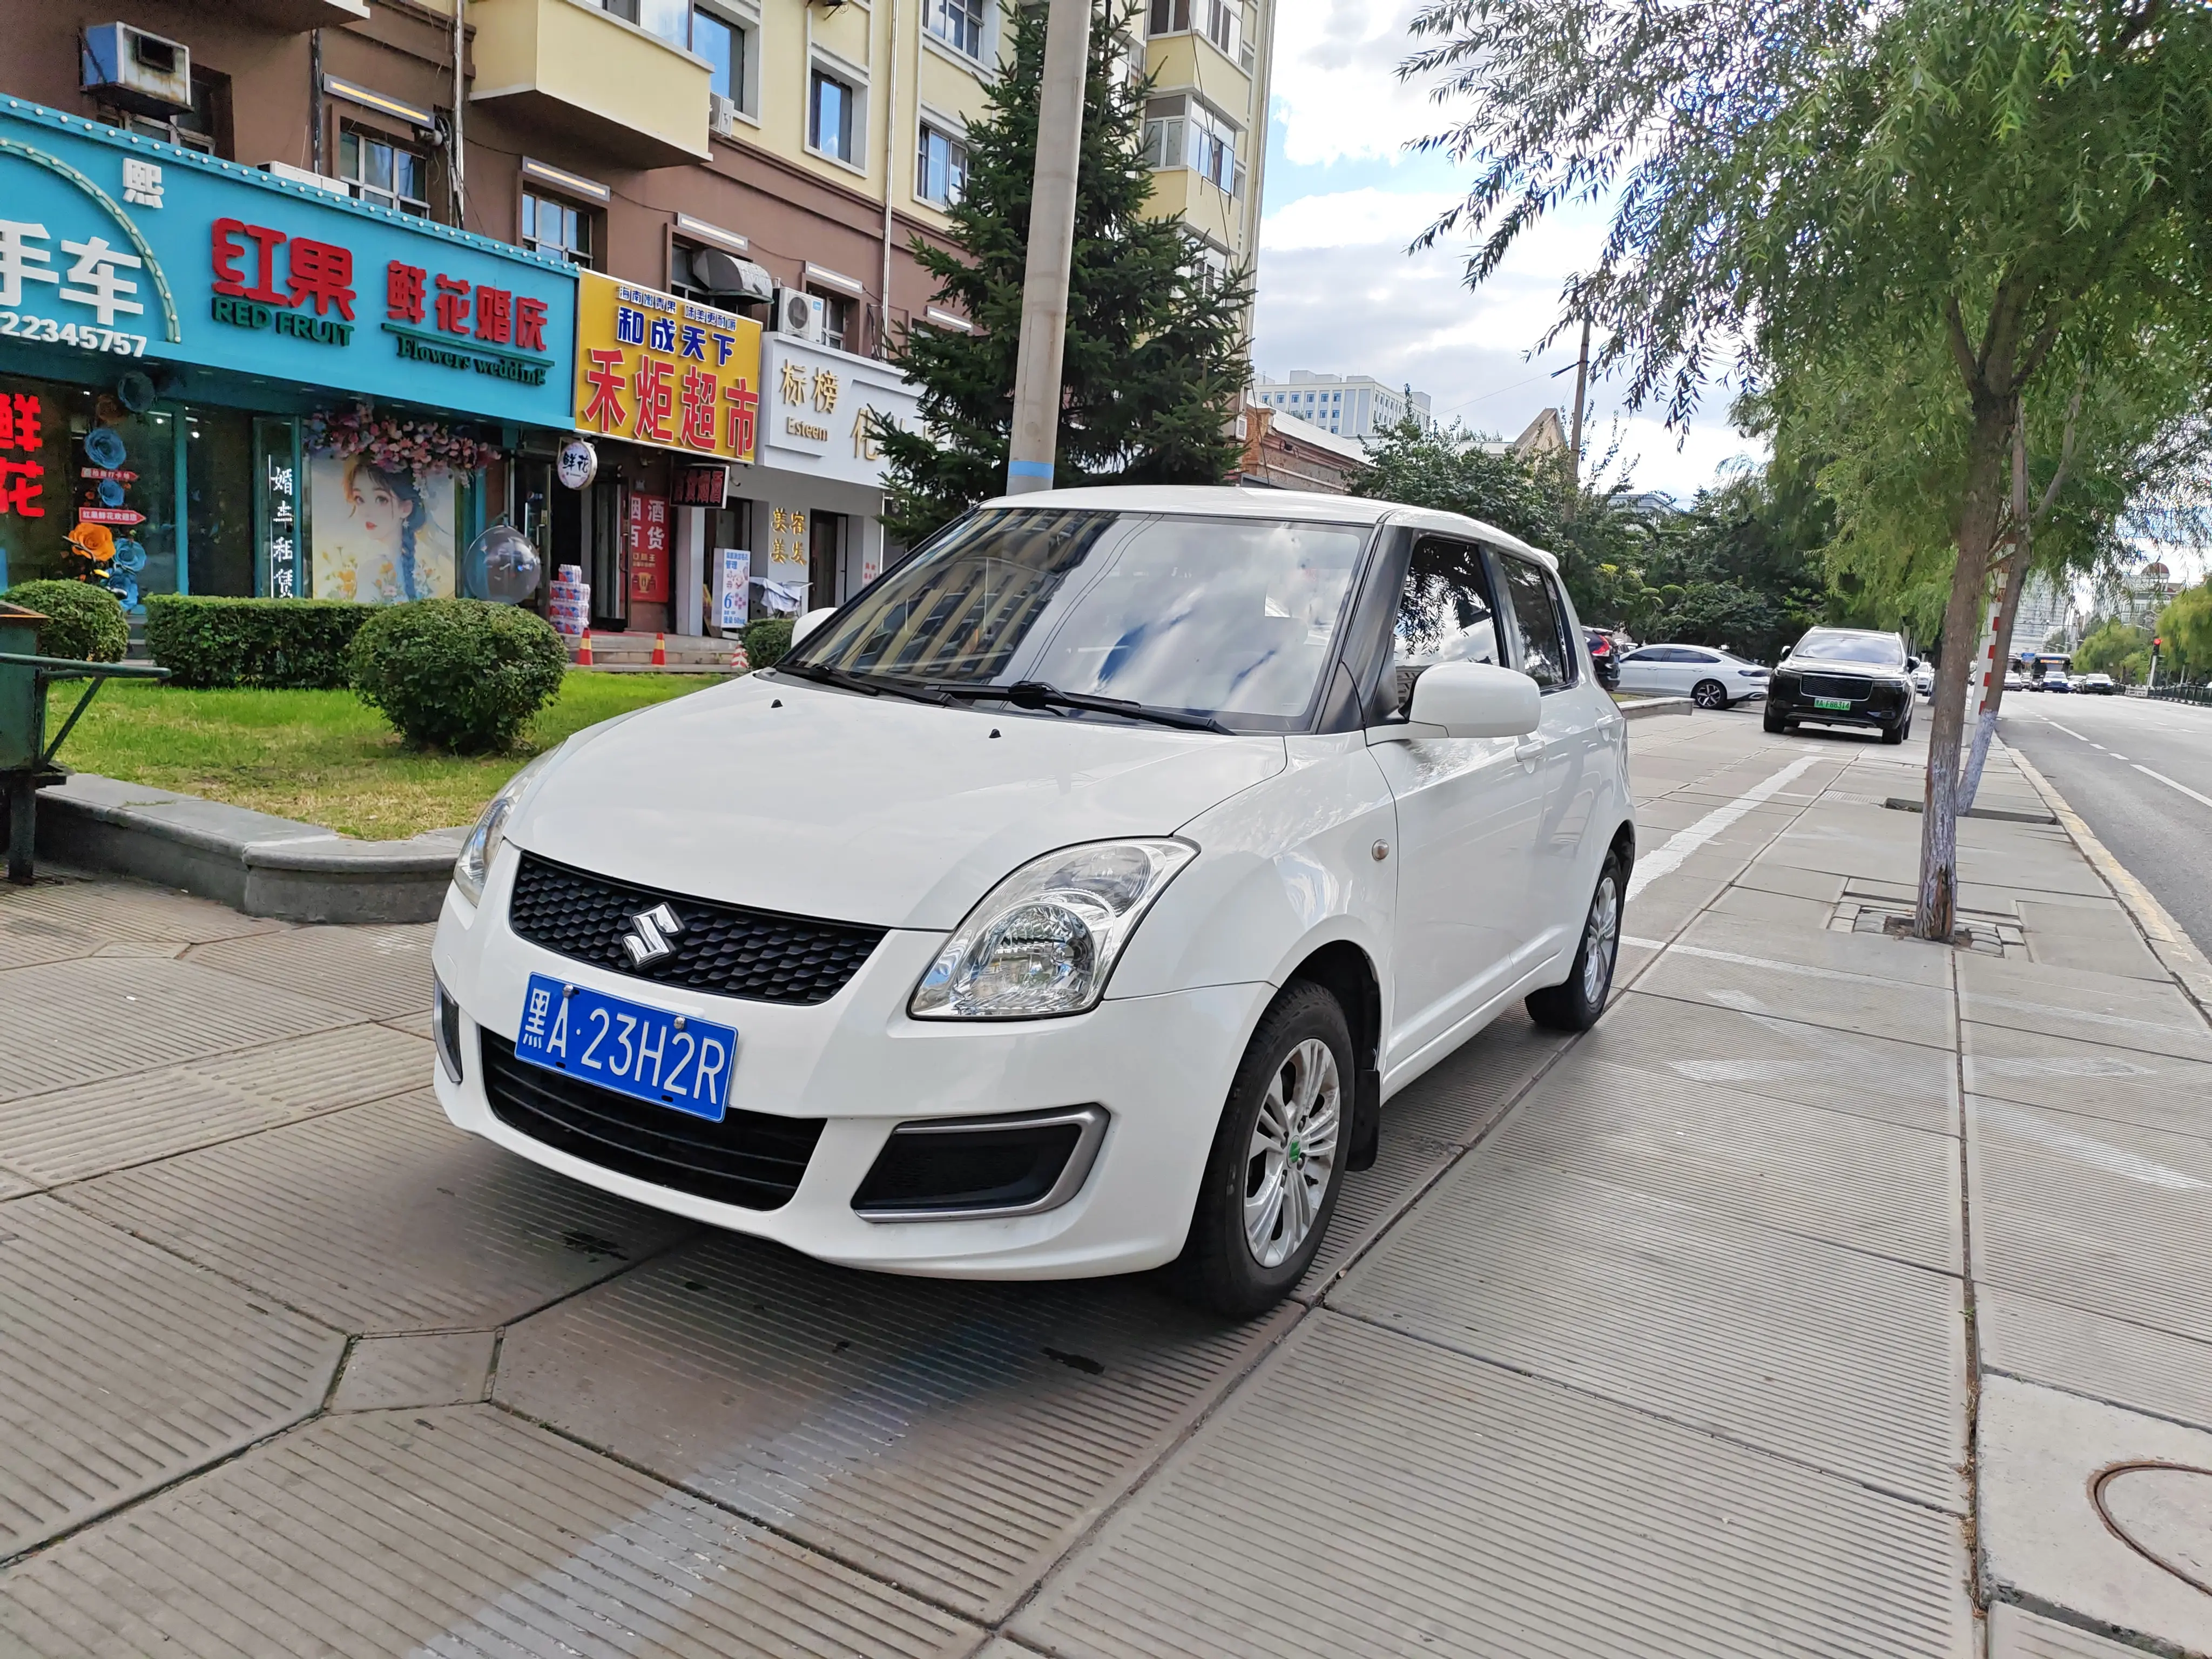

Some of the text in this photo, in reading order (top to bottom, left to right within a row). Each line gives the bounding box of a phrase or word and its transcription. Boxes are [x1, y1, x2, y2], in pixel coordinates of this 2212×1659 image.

[211, 218, 356, 321] 红果
[211, 296, 355, 347] RED FRUIT
[387, 260, 548, 351] 鲜花婚庆
[0, 311, 147, 358] 22345757
[617, 306, 736, 367] 和成天下
[396, 335, 547, 386] Flowers wedding
[584, 347, 759, 458] 禾炬超市
[779, 358, 840, 415] 标榜
[787, 416, 828, 441] Esteem
[562, 450, 589, 473] 鲜花
[771, 507, 807, 536] 美容
